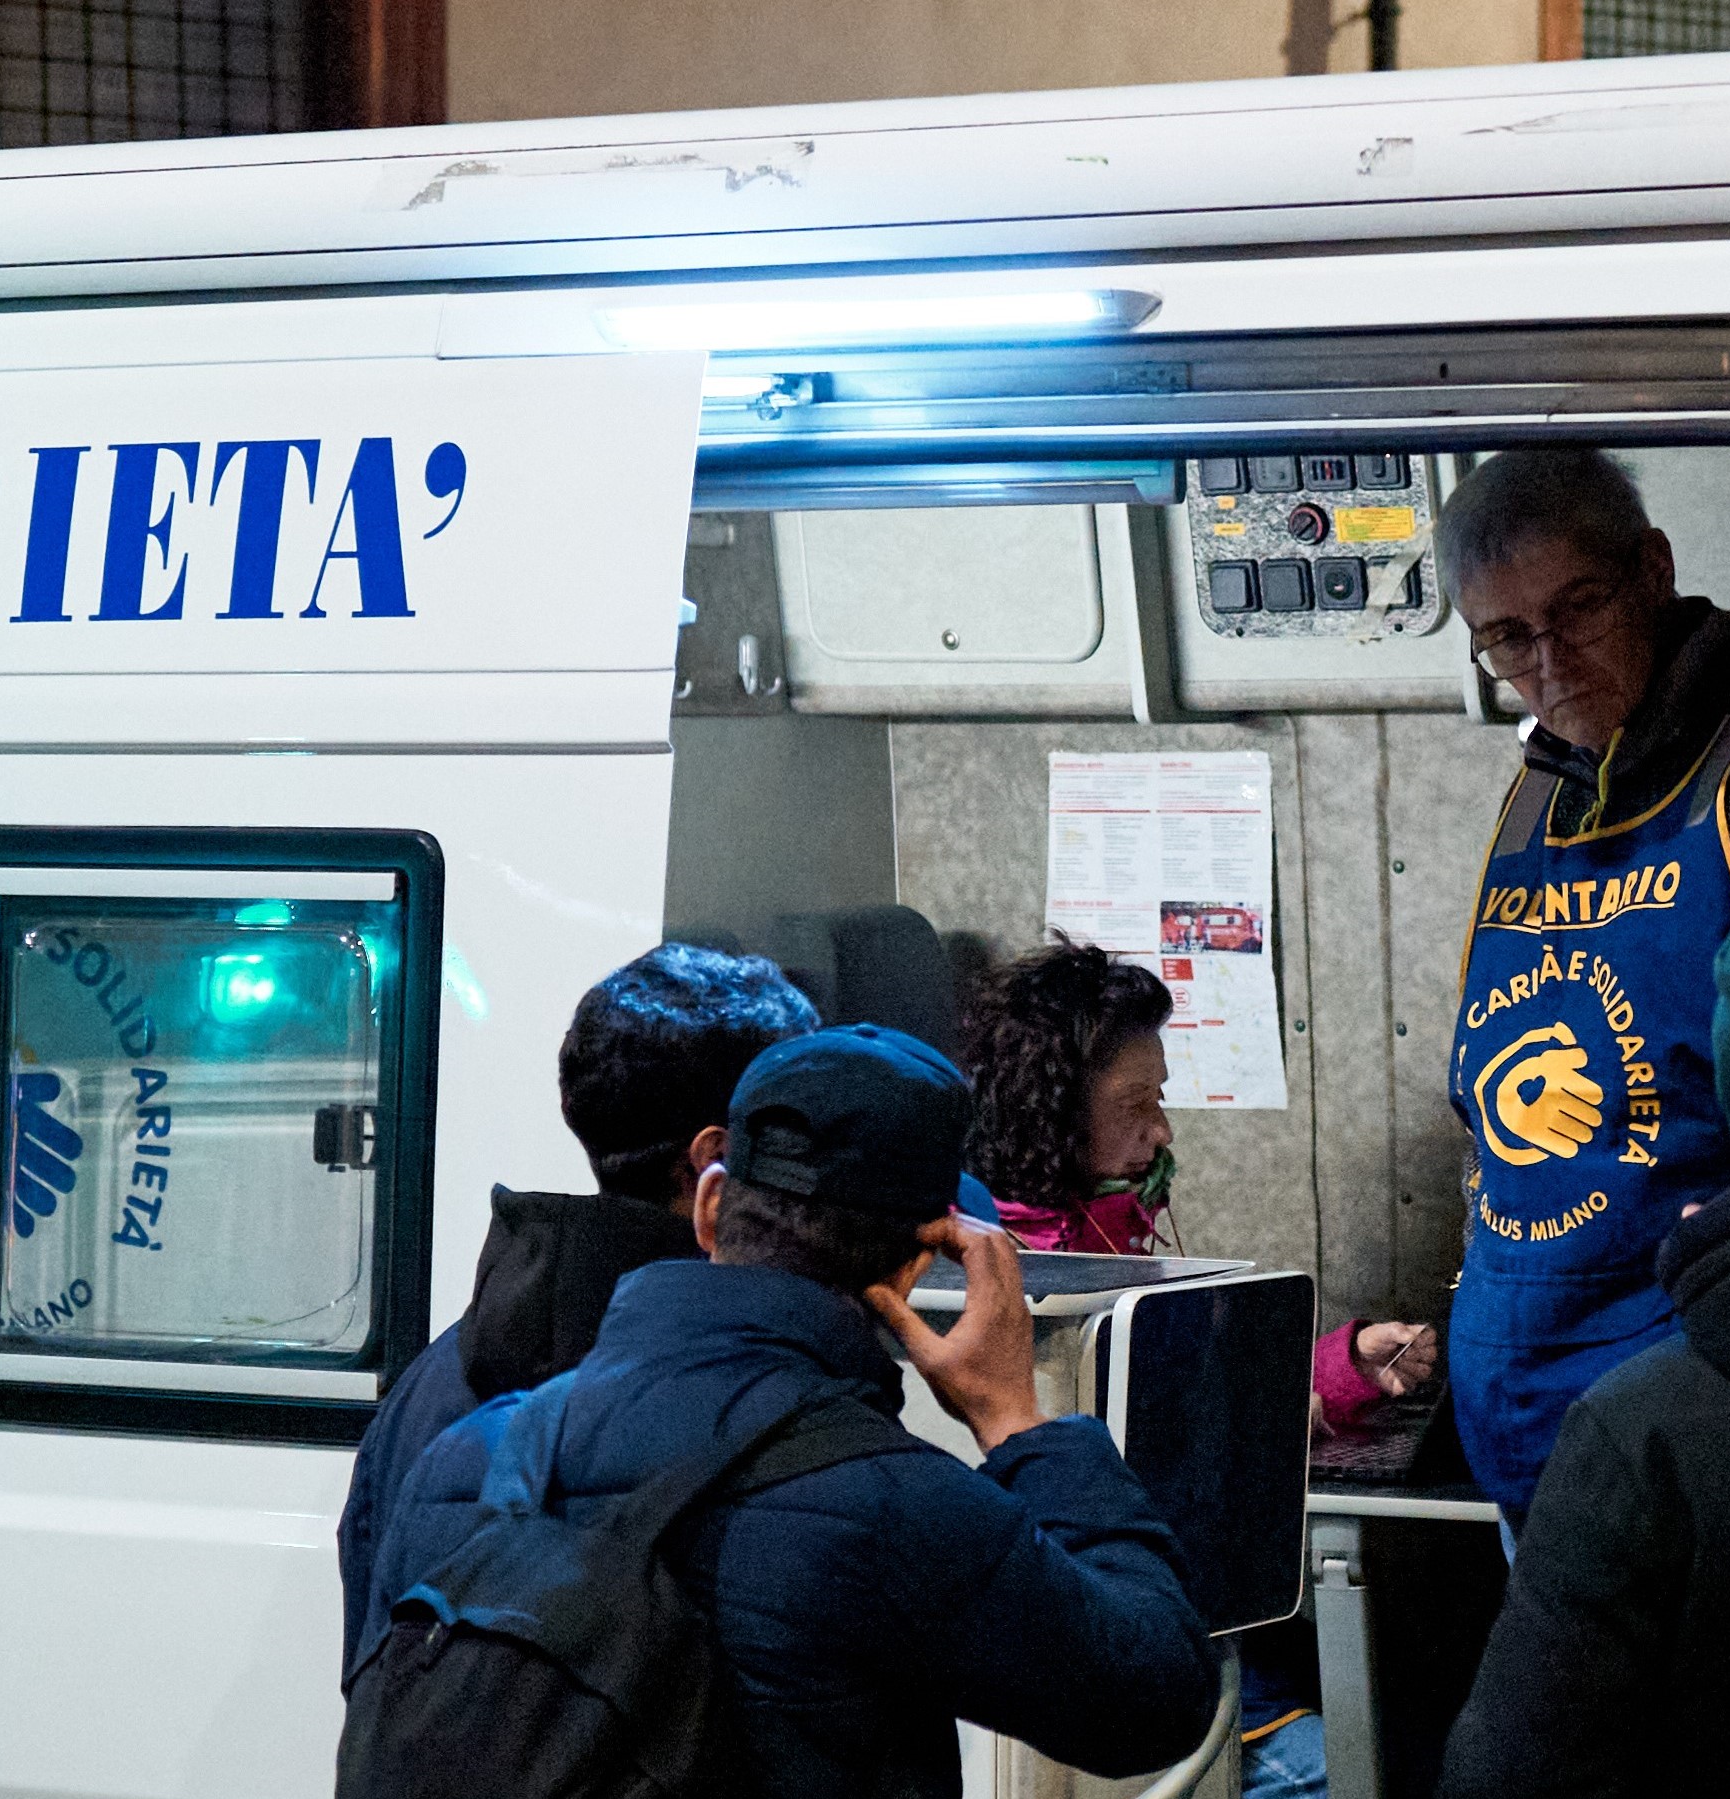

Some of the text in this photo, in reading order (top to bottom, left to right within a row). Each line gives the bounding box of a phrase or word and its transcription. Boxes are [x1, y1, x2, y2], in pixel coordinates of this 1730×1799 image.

[1481, 861, 1681, 928] VOLNTARIO
[46, 926, 172, 1252] SOLIDARIETÀ
[1567, 950, 1587, 981] E
[1588, 955, 1661, 1168] SOLIDARIETÀ
[1531, 1191, 1609, 1242] MILANO
